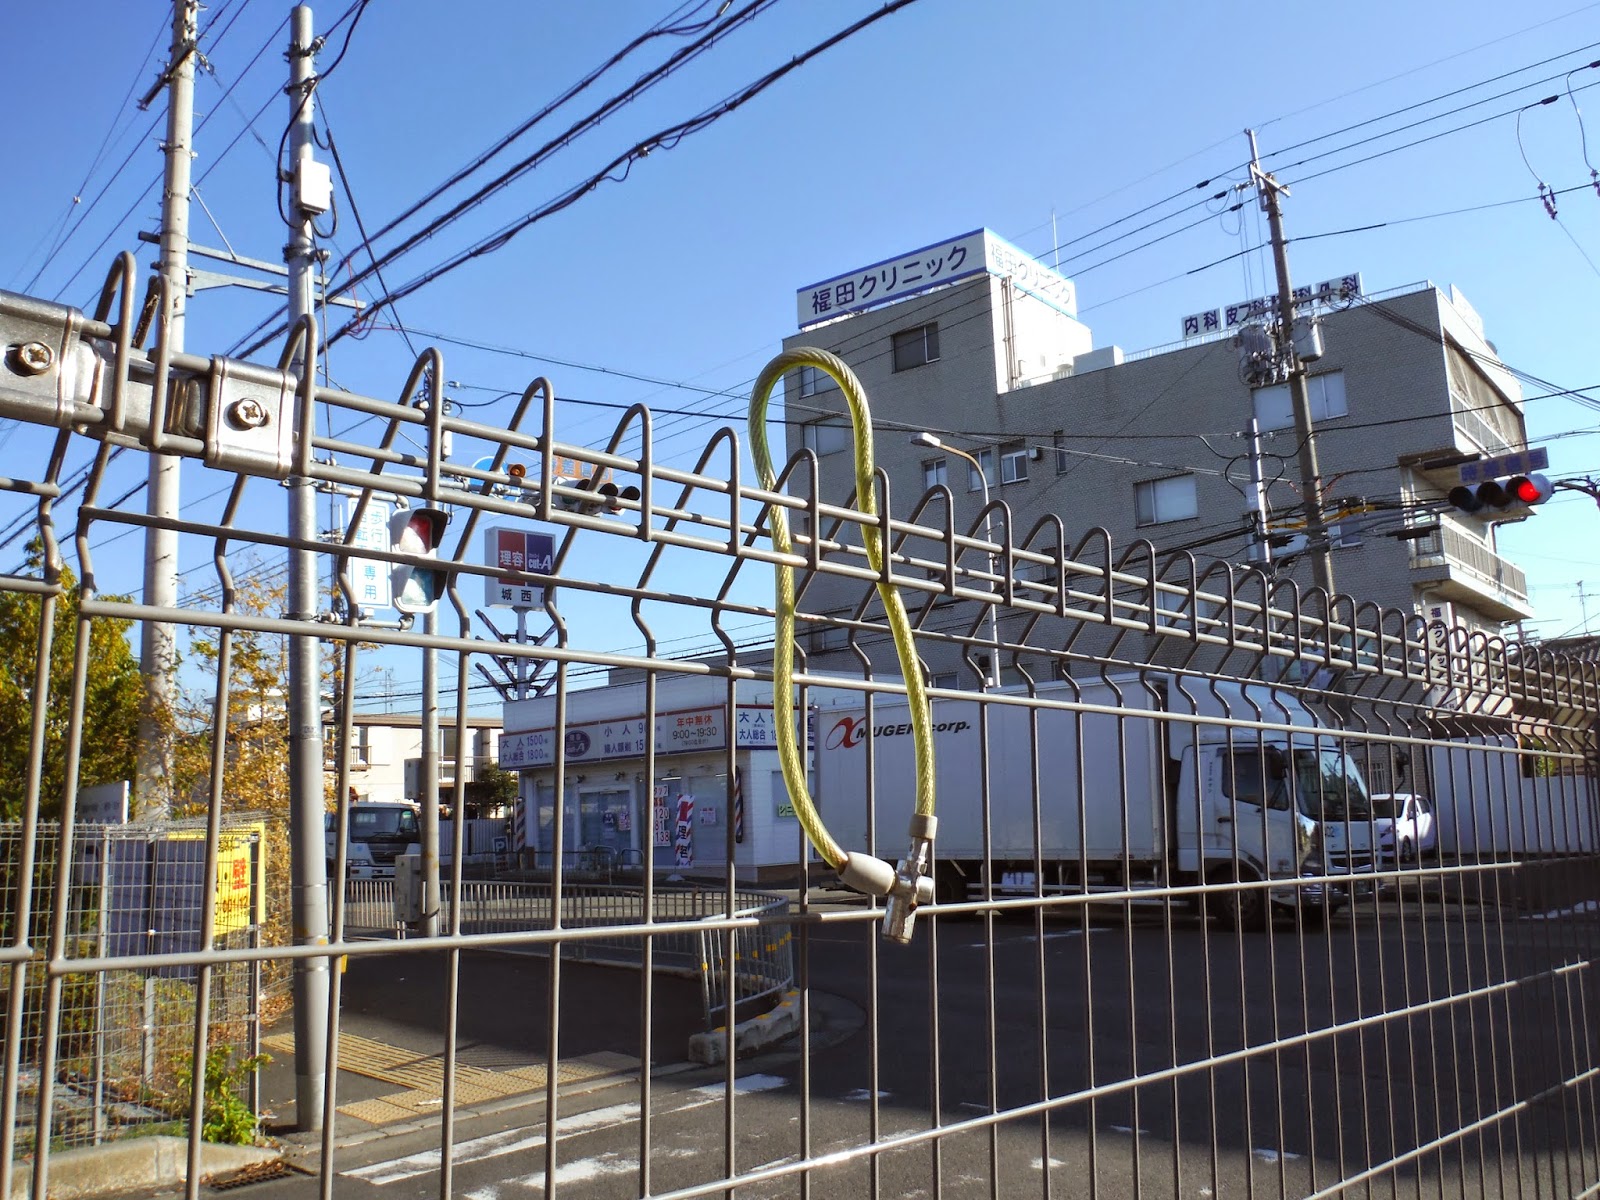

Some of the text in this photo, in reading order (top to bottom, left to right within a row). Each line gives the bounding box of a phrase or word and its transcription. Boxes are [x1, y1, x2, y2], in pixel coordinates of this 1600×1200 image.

[811, 245, 967, 315] 福田クリニック
[1184, 310, 1219, 336] 内科
[500, 550, 524, 567] 理容
[501, 588, 543, 603] 城西
[677, 714, 713, 727] 年中無休
[738, 712, 766, 723] 大人
[604, 724, 631, 737] 小人
[739, 729, 766, 740] 大人総合
[502, 737, 525, 748] 大人
[527, 734, 543, 746] 1500
[527, 748, 544, 760] 1800
